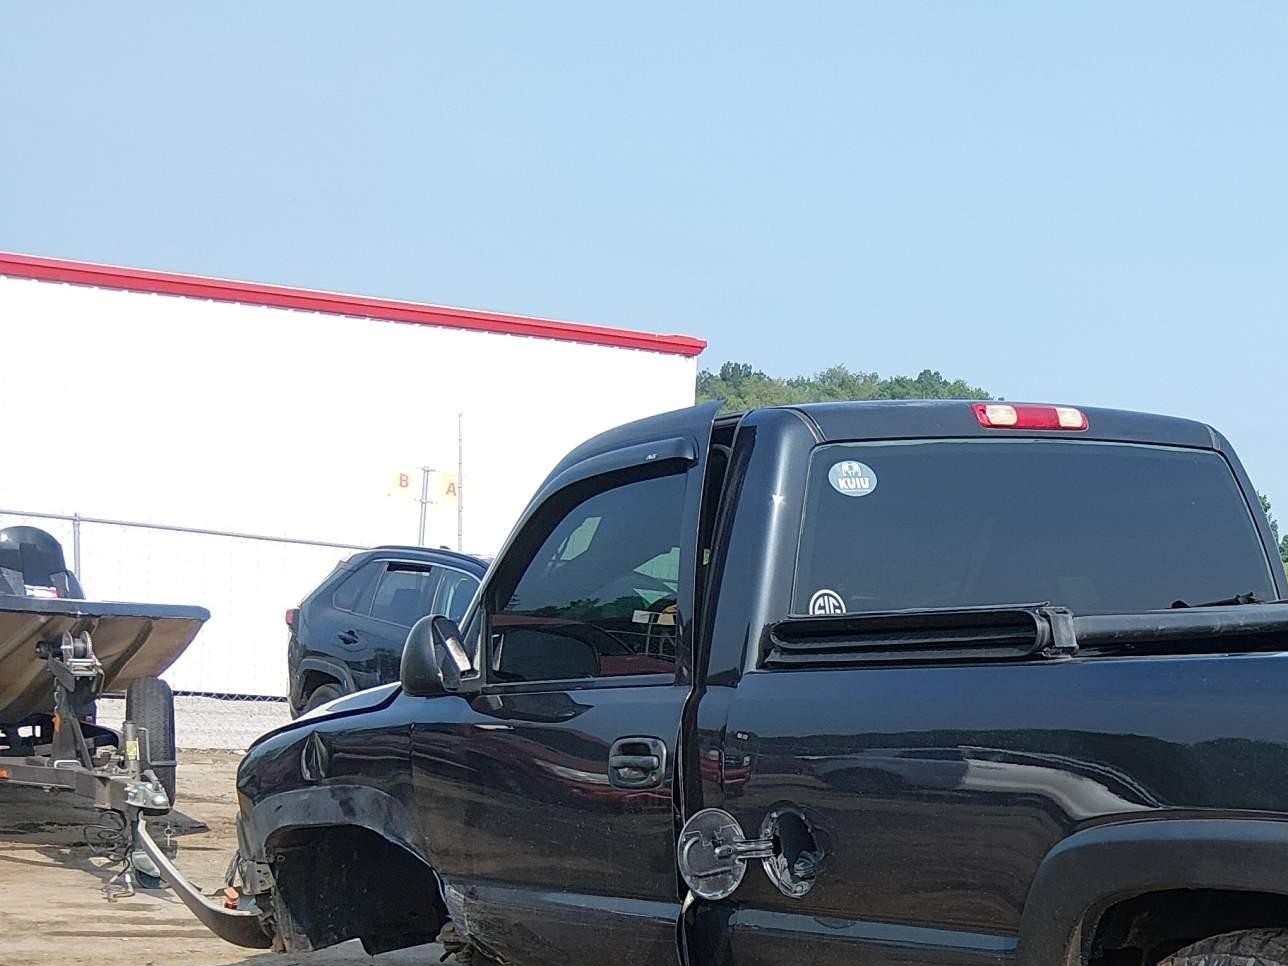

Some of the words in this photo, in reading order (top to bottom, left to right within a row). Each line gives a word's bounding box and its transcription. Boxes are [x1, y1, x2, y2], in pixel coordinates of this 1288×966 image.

[399, 472, 409, 488] B
[837, 477, 871, 490] KUIU
[445, 481, 457, 497] A
